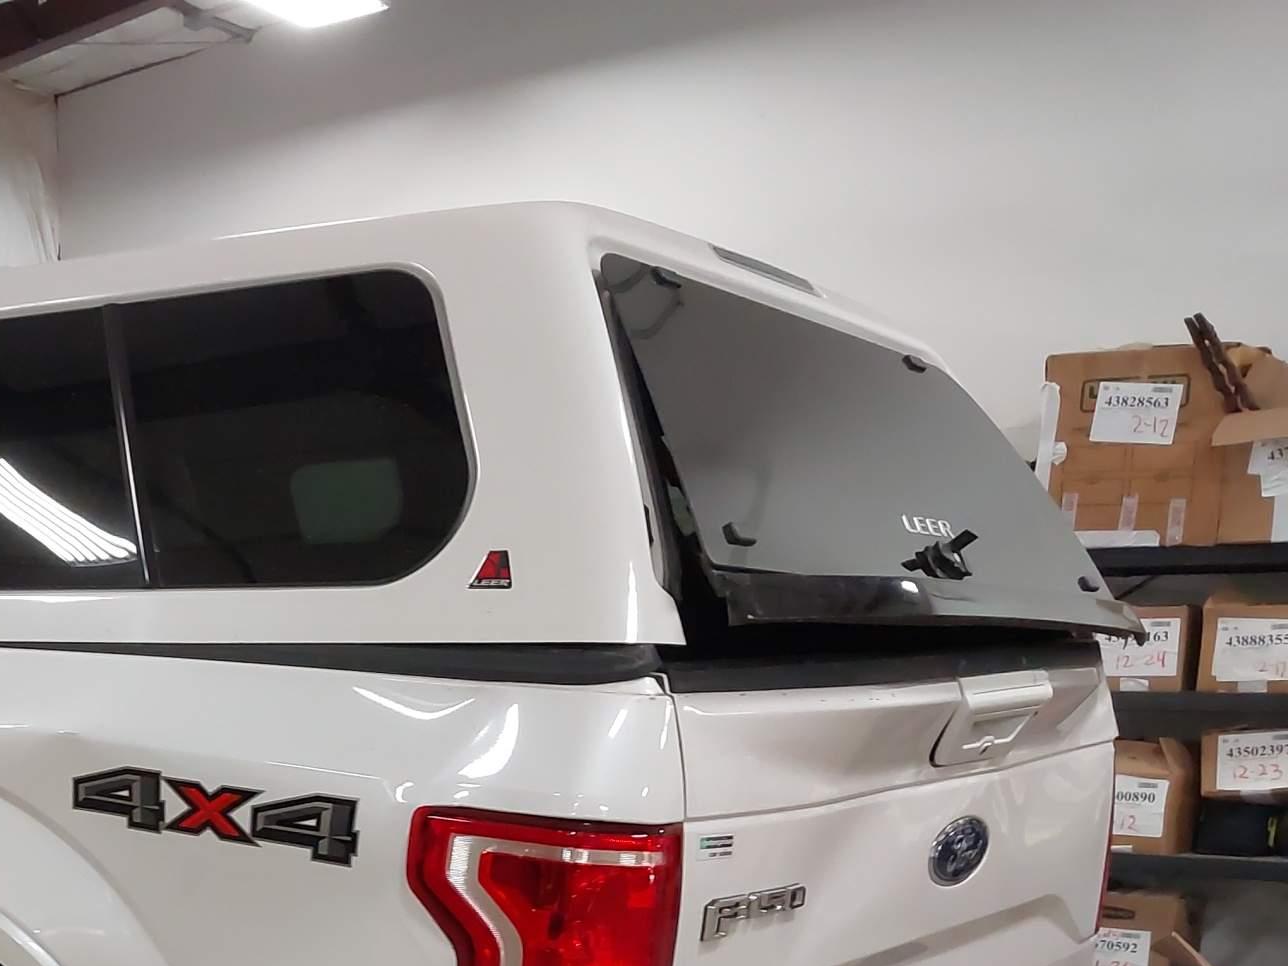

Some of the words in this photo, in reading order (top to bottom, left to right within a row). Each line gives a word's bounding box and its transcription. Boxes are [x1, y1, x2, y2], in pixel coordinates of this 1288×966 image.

[1103, 395, 1169, 409] 43828563
[901, 514, 955, 539] LEER
[1095, 939, 1138, 954] 70592
